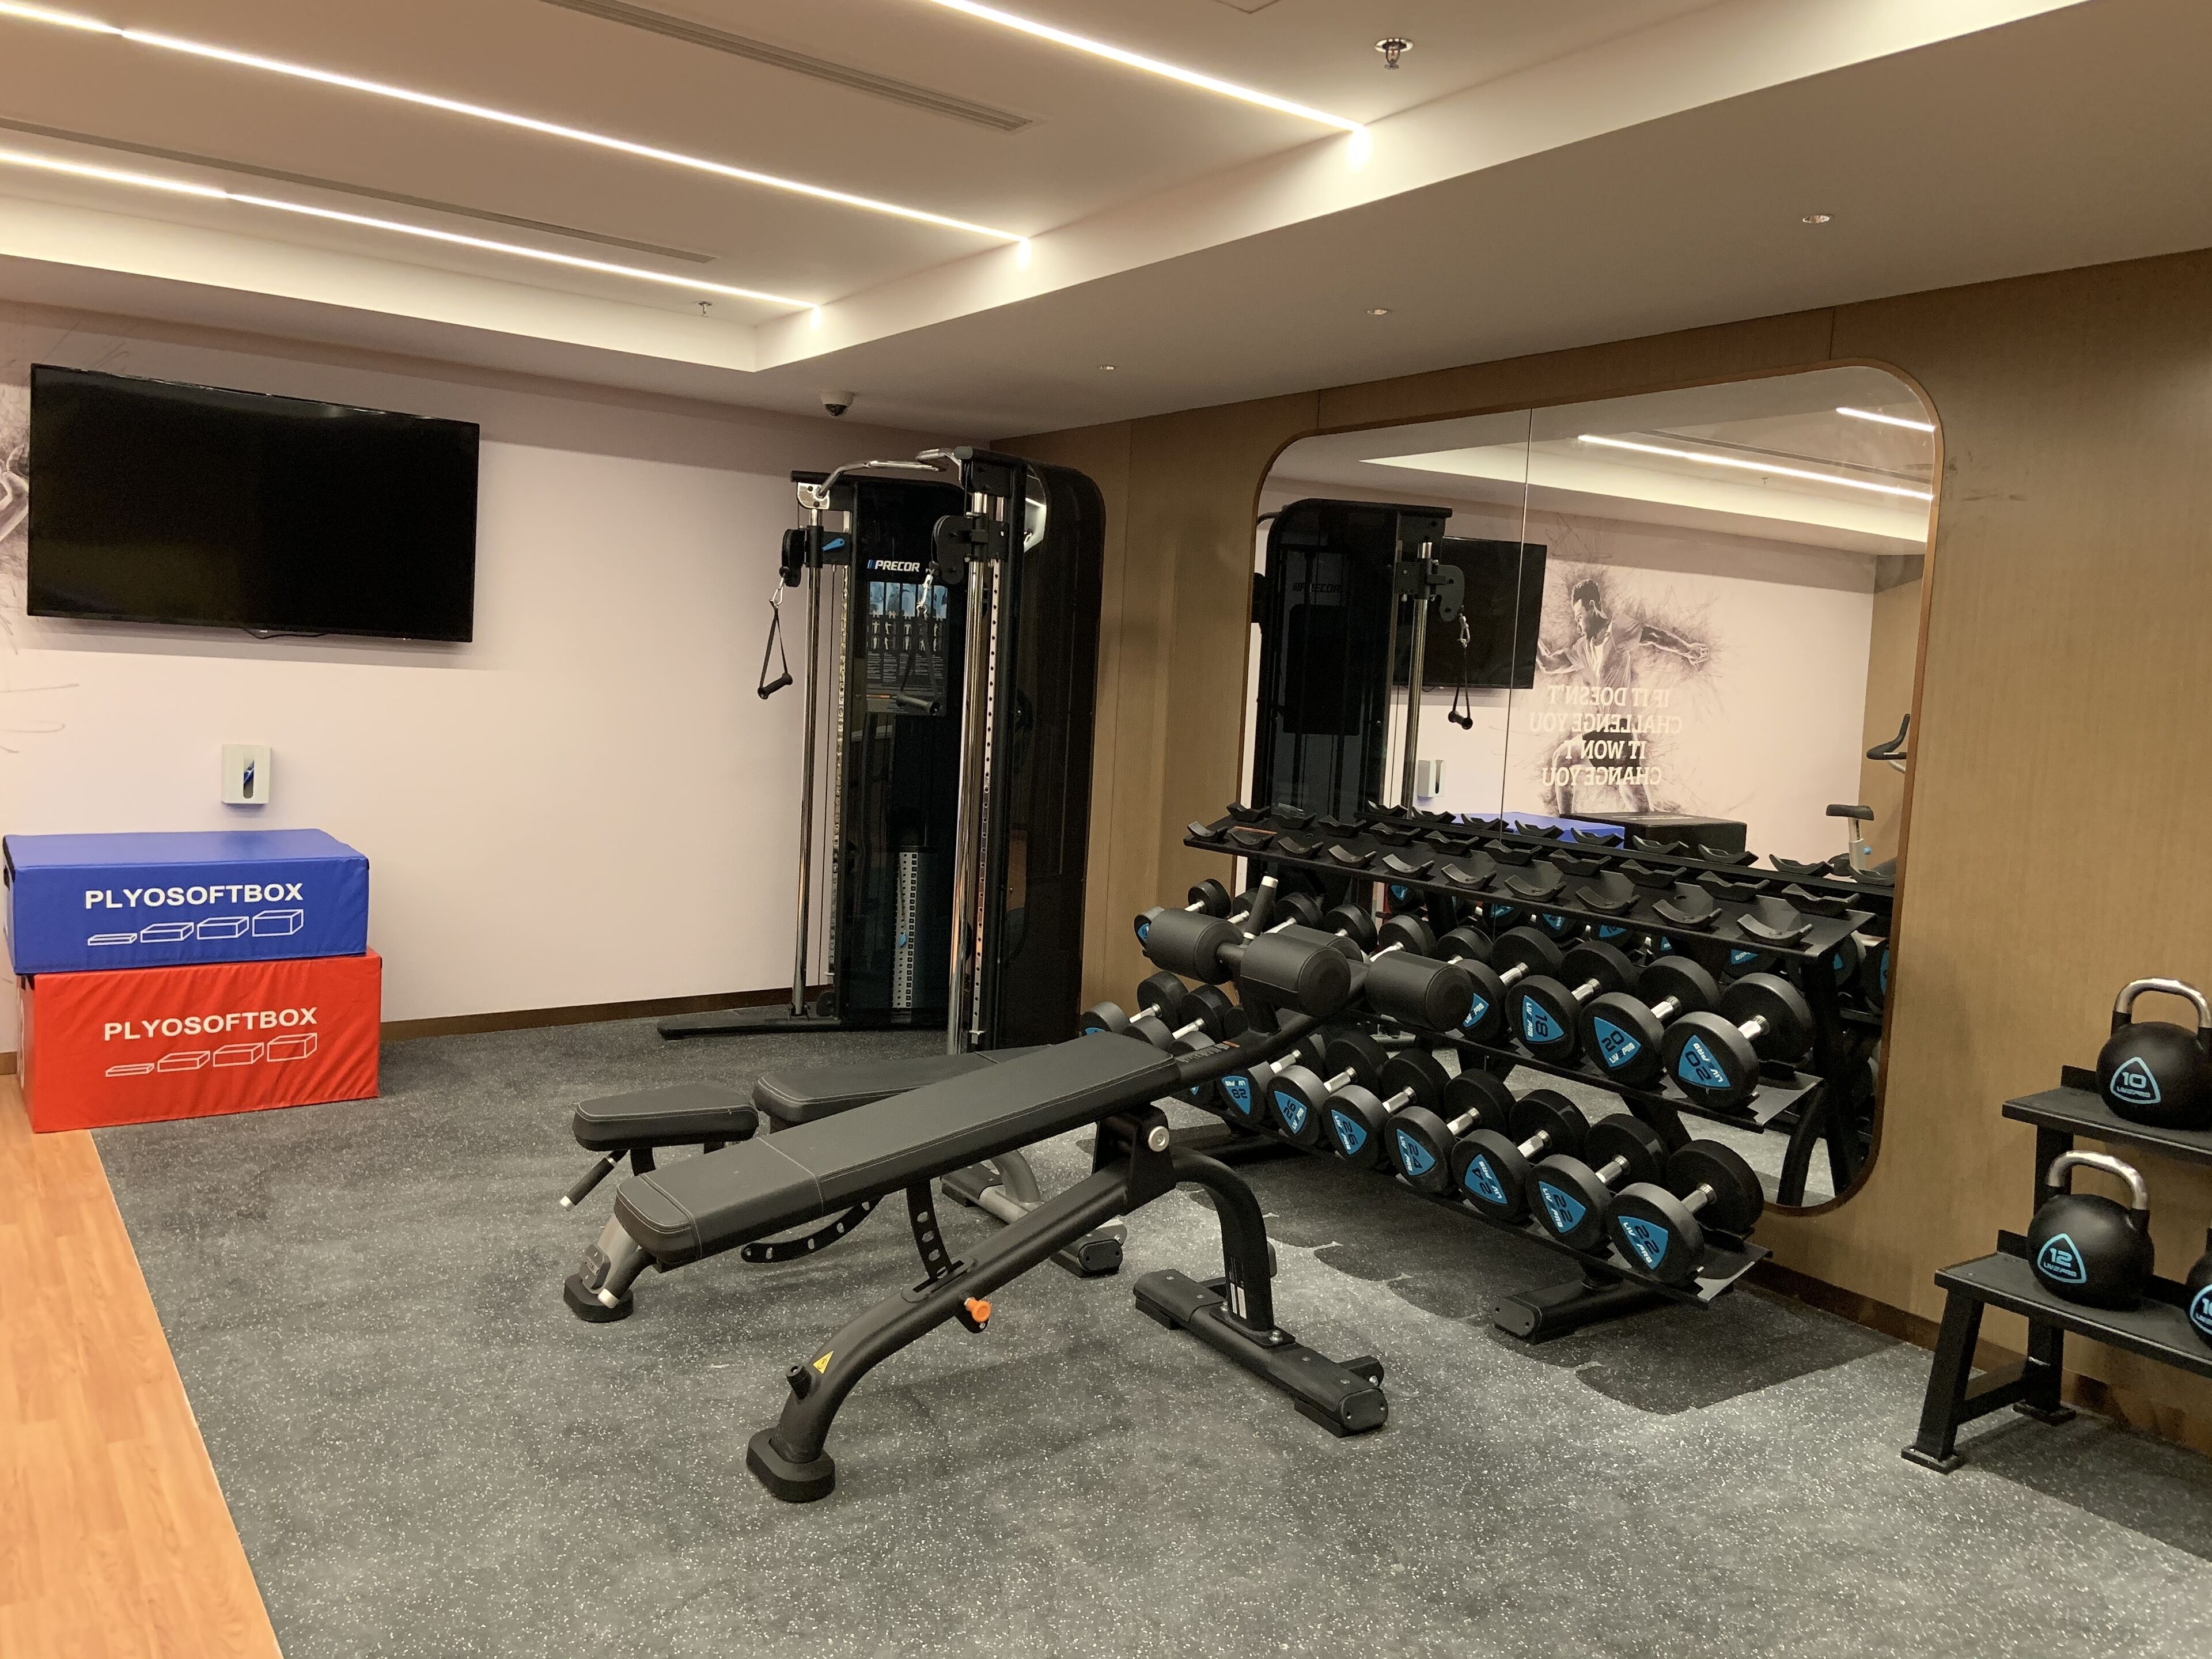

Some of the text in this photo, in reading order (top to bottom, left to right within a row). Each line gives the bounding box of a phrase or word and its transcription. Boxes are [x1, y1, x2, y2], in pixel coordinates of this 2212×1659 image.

[874, 560, 920, 572] PRECOR
[85, 882, 304, 910] PLYOSOFTBOX
[104, 1006, 317, 1041] PLYOSOFTBOX
[1535, 1014, 1548, 1037] 18
[1601, 1030, 1625, 1052] 20
[1685, 1050, 1712, 1081] 20
[2122, 1071, 2146, 1089] 10
[1232, 1088, 1248, 1099] 28
[1283, 1099, 1296, 1120] 26
[1342, 1120, 1358, 1146] 26
[1408, 1143, 1422, 1169] 24
[1472, 1168, 1493, 1194] 24
[1553, 1194, 1573, 1223] 22
[1634, 1224, 1660, 1255] 22
[2050, 1248, 2073, 1267] 12
[2202, 1298, 2212, 1317] 1
